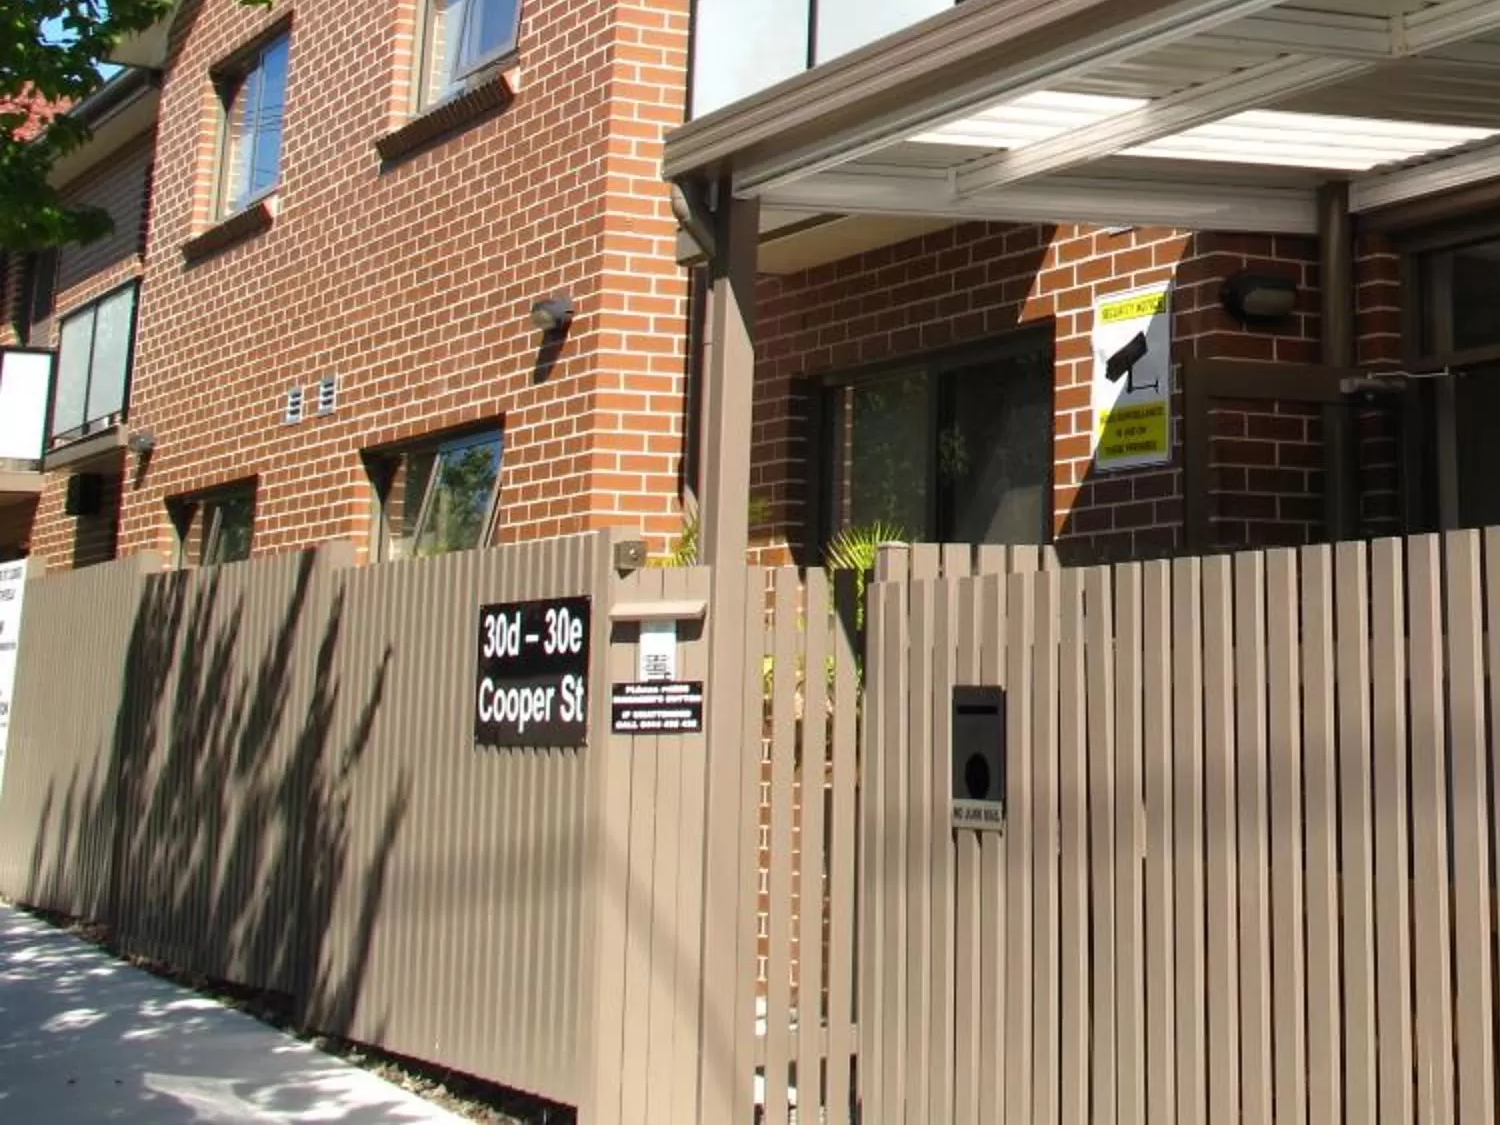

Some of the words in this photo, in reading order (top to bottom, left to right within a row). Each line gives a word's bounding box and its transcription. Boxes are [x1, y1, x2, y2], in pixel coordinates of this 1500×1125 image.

[483, 611, 521, 658] 30d
[544, 606, 583, 655] 30e
[478, 677, 555, 734] Cooper
[559, 674, 584, 722] St
